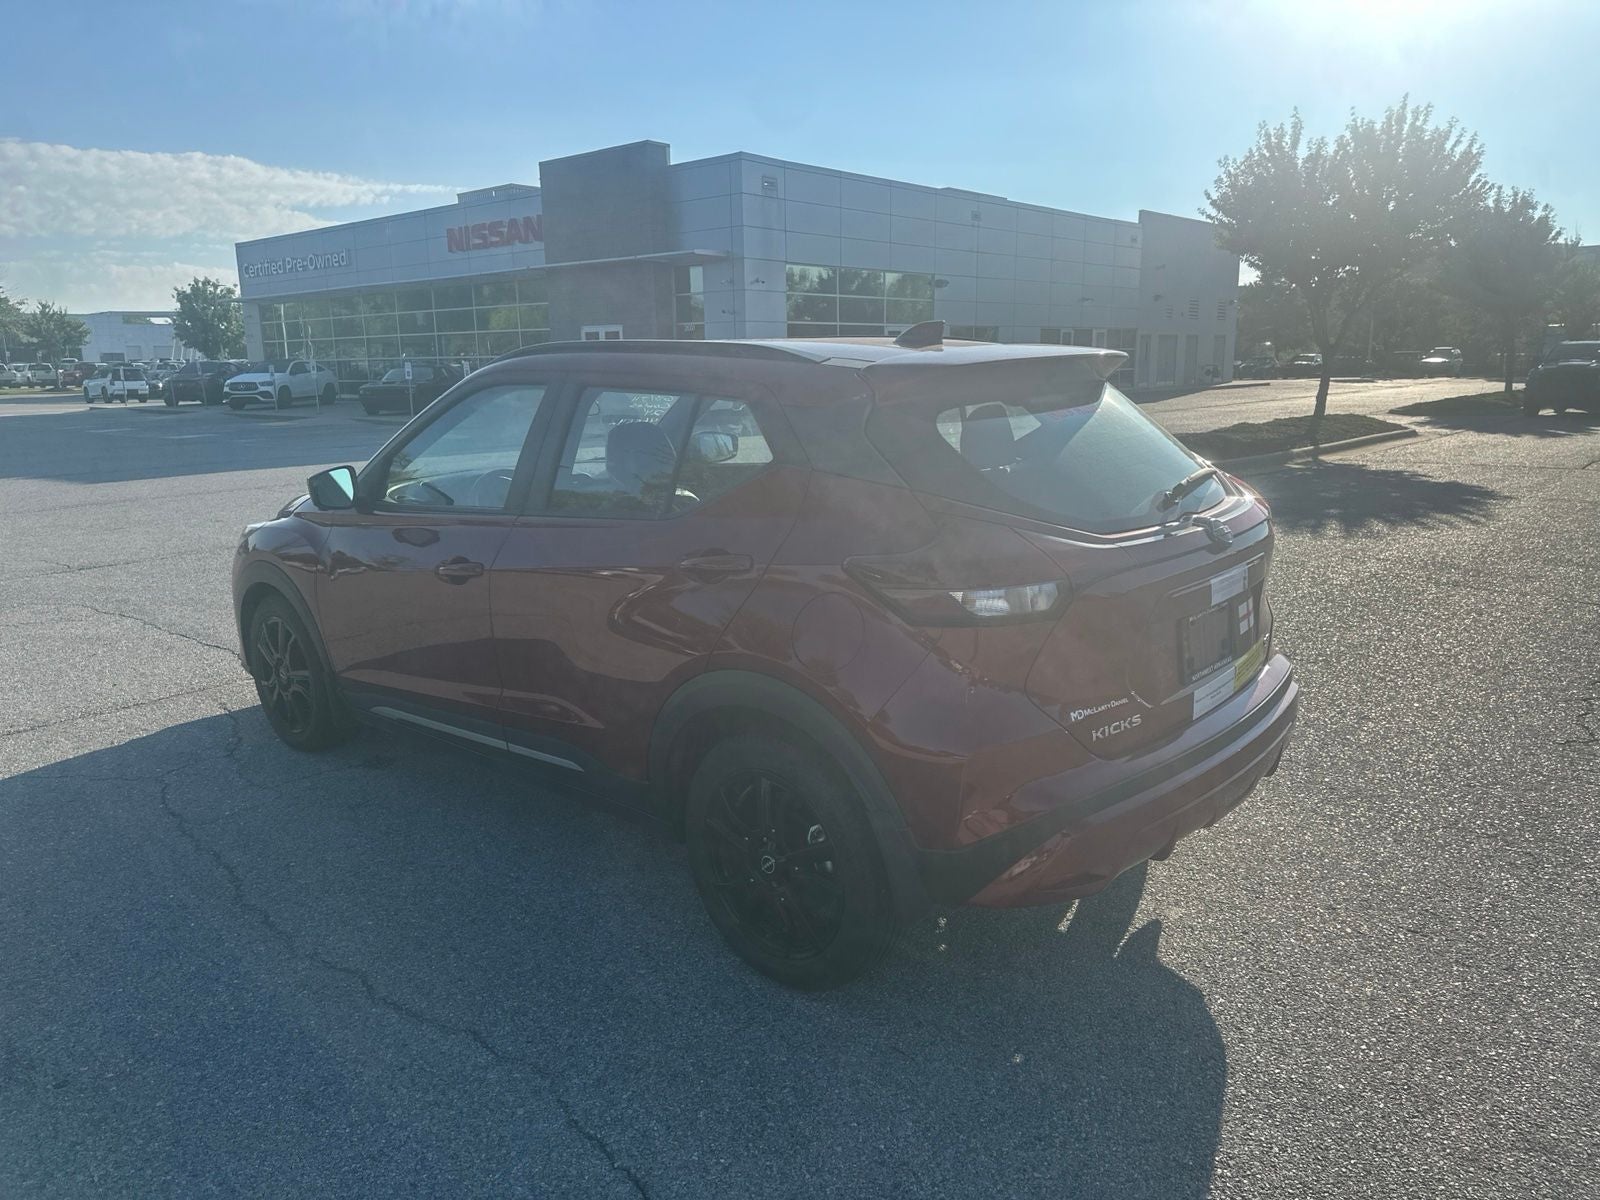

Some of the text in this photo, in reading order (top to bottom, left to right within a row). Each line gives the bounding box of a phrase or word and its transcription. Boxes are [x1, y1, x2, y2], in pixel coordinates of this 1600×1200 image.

[446, 214, 544, 253] NISSAN
[242, 248, 347, 278] Certified Pre-Owned
[1091, 713, 1143, 742] KICKS
